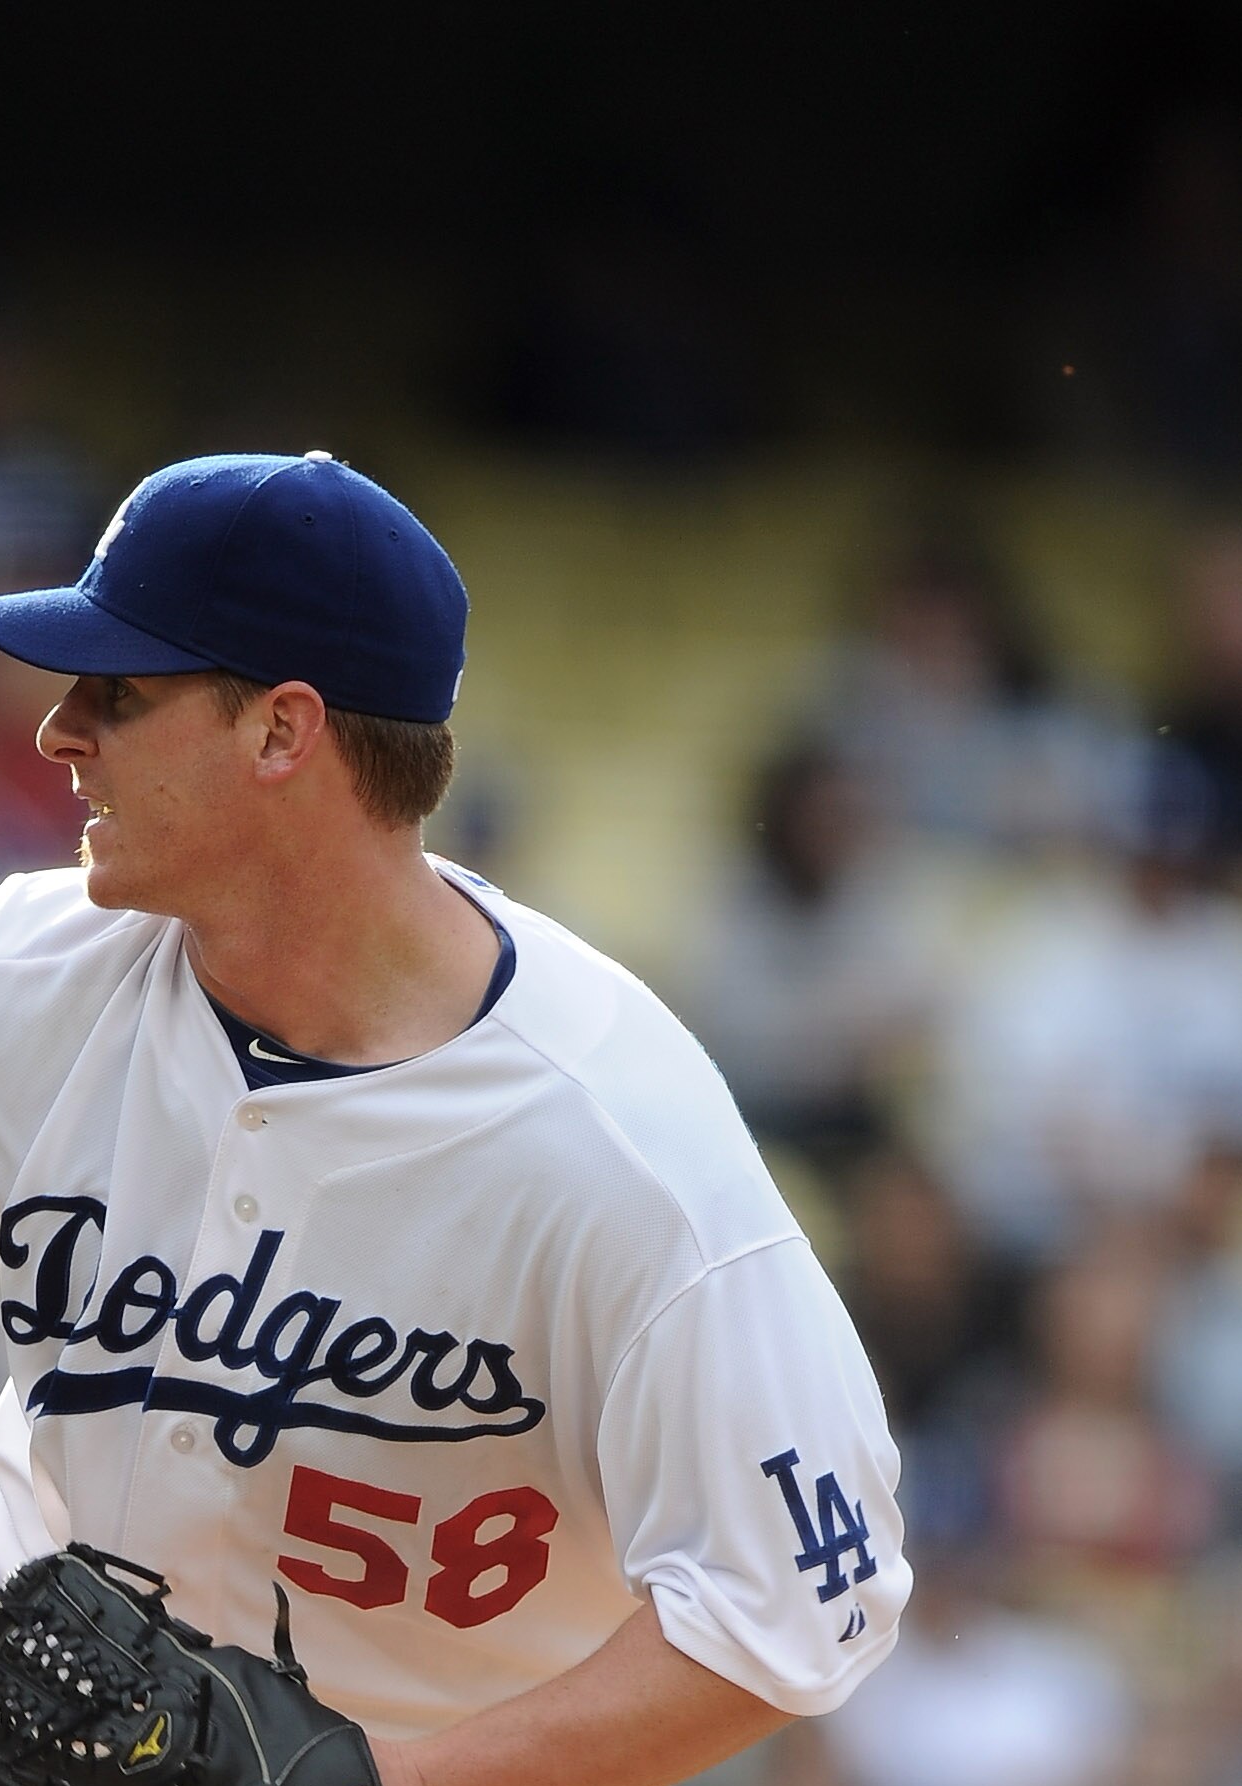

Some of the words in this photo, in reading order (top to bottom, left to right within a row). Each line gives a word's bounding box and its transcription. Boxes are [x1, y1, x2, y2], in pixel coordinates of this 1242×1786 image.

[0, 1195, 546, 1467] Dodgers
[277, 1464, 559, 1629] 58
[760, 1447, 877, 1603] LA
